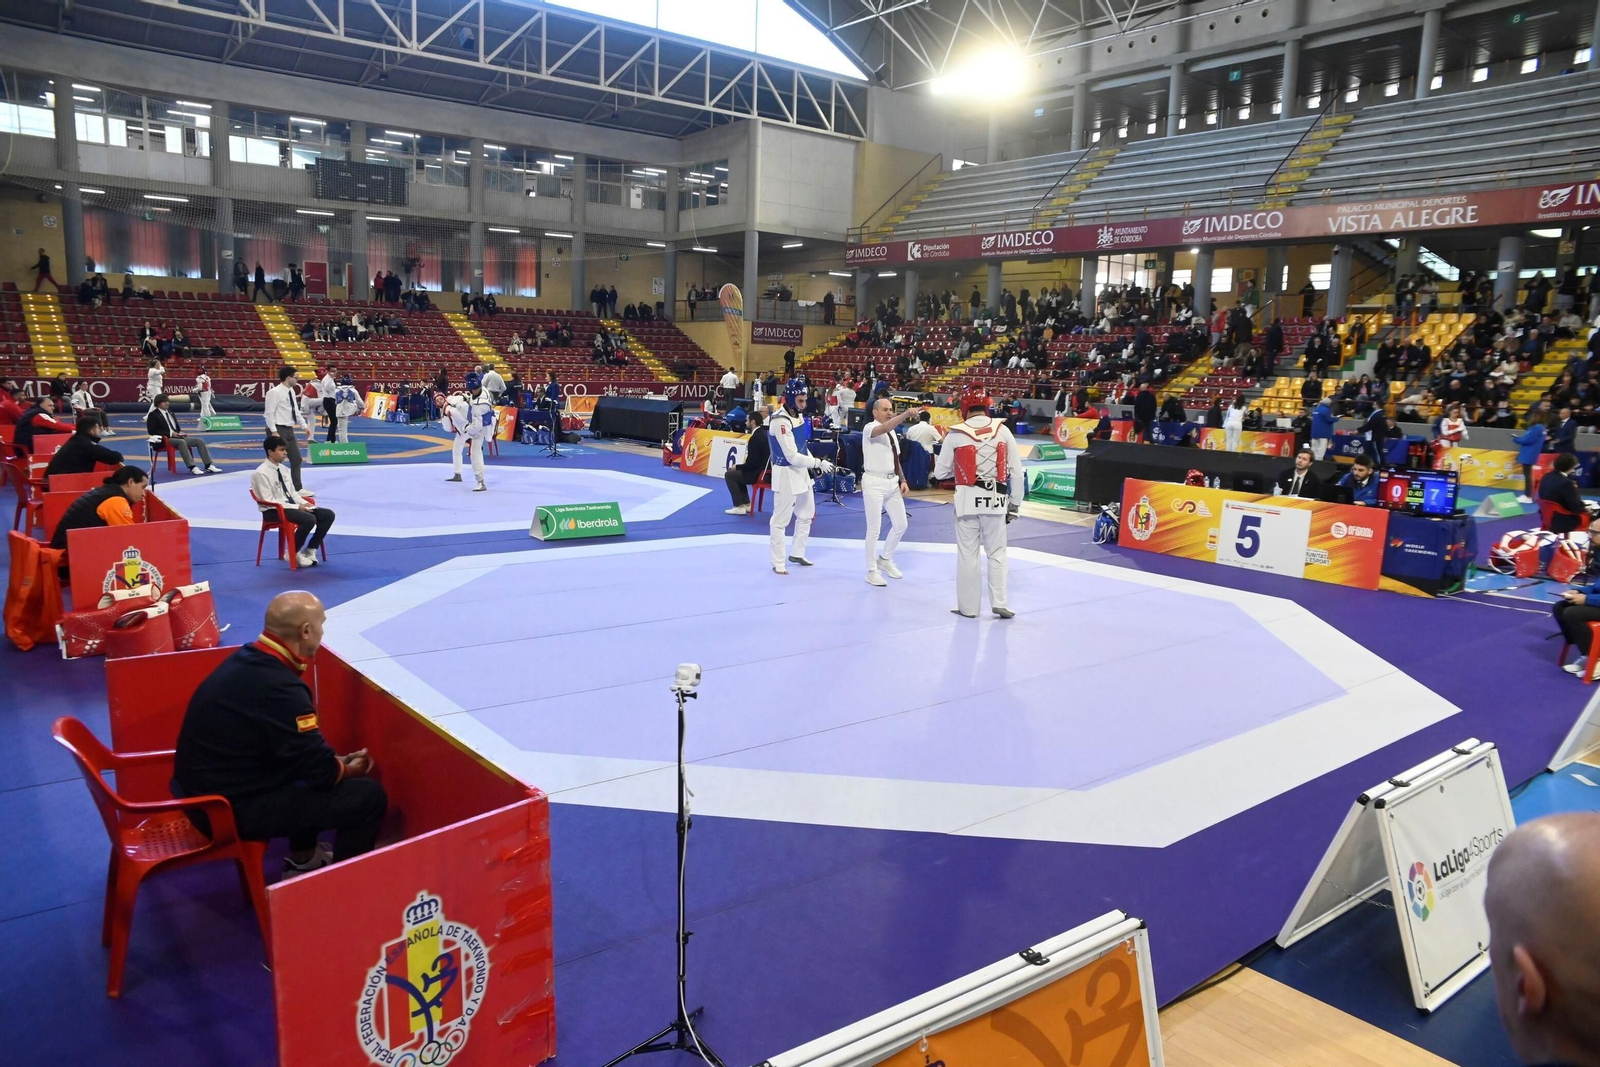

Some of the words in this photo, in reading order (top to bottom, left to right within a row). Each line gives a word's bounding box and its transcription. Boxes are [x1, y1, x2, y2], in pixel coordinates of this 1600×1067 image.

[1338, 204, 1372, 214] PALACIO
[1374, 200, 1420, 210] MUNICIPAL
[1422, 196, 1468, 207] DEPORTES
[1204, 211, 1284, 233] IMDECO
[1328, 213, 1383, 233] VISTA
[1389, 205, 1479, 229] ALEGRE
[997, 230, 1055, 248] IMDECO
[1114, 226, 1148, 235] AYUNTAMIENTO
[855, 246, 887, 258] IMDECO
[923, 243, 950, 251] Diputación
[765, 328, 801, 338] IMDECO
[726, 446, 737, 471] 6
[1391, 485, 1402, 497] 0
[1430, 489, 1440, 501] 7
[577, 518, 618, 528] Iberdrola
[1235, 514, 1262, 559] 5
[445, 925, 461, 938] DE
[384, 925, 443, 965] ESPAÑOLA
[460, 929, 486, 994] TAEKWONDO
[360, 965, 387, 1046] FEDERACIÓN
[371, 1041, 397, 1064] REAL
